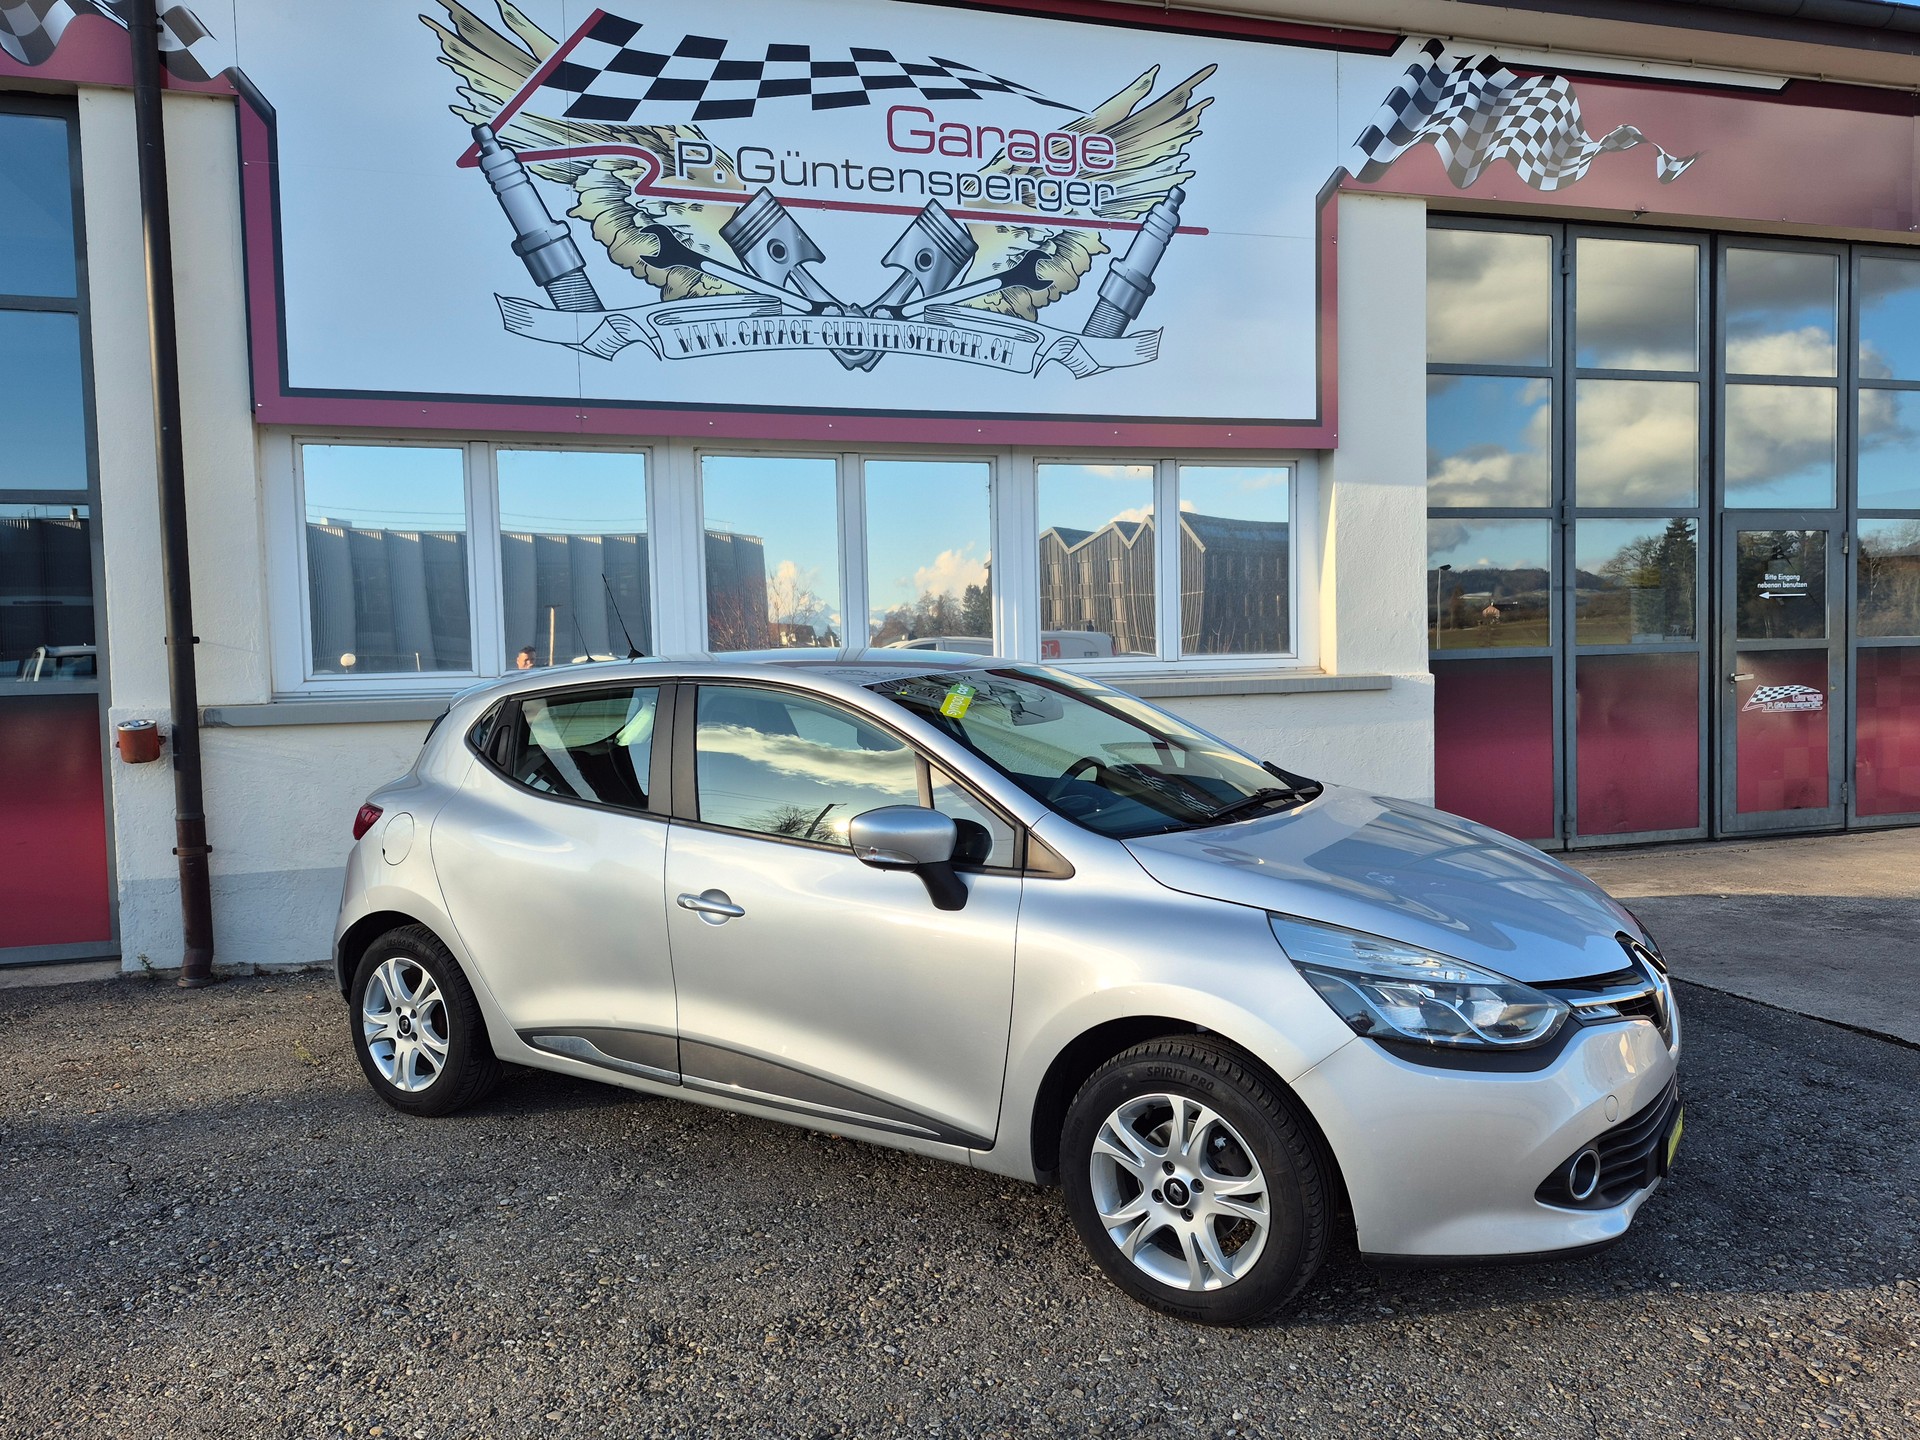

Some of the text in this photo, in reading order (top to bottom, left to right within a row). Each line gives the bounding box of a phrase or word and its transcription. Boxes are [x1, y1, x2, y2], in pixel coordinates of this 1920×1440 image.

[886, 104, 1115, 177] Garage
[677, 141, 1115, 212] P. Güntensperger
[673, 319, 1016, 366] WWW.GARAGE-GUENTENSPERGER.CH
[1778, 573, 1800, 581] Eingang
[1146, 1066, 1215, 1091] SPIRIT PRO
